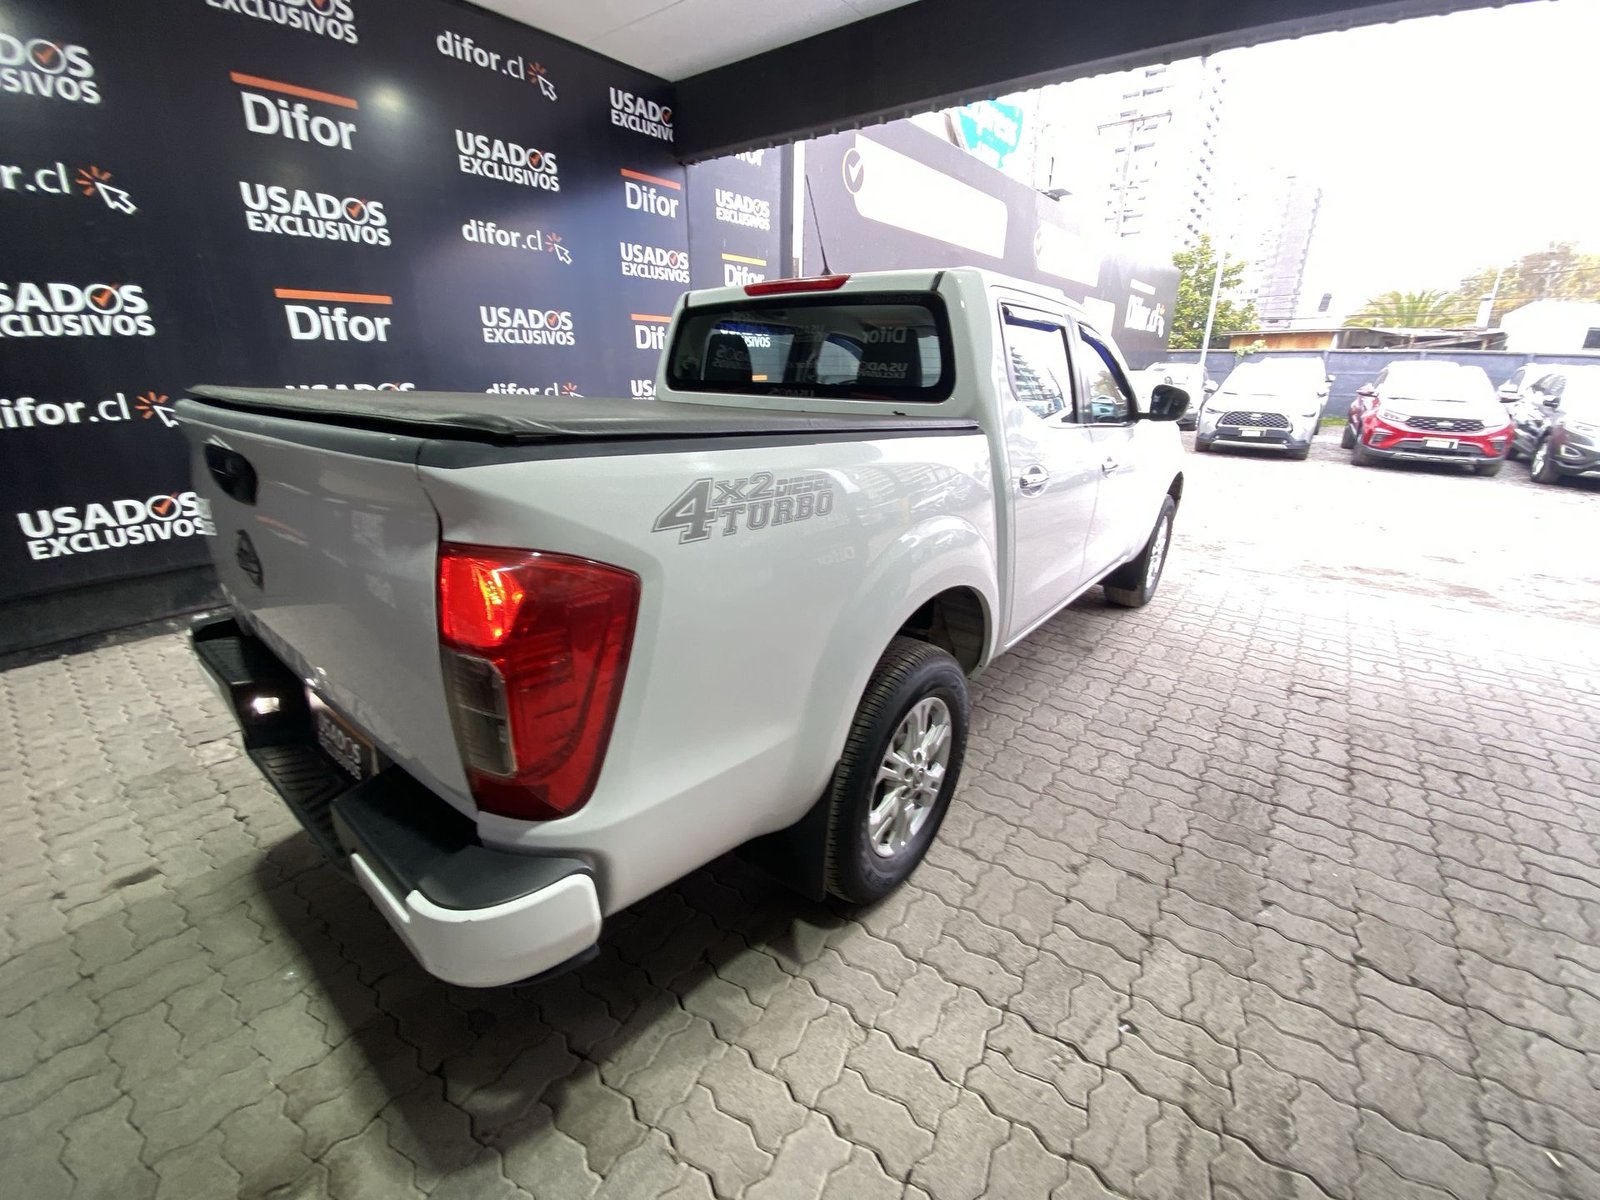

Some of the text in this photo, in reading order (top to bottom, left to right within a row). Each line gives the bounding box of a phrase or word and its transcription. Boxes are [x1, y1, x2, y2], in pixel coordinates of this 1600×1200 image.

[437, 30, 525, 80] difor.cl
[240, 91, 357, 150] Difor
[455, 130, 557, 175] USADOS
[459, 154, 560, 192] EXCLUSIVOS
[239, 181, 388, 227] USADOS
[625, 182, 679, 218] Difor
[715, 189, 770, 218] USADOS
[245, 210, 391, 247] EXCLUSIVOS
[462, 219, 543, 251] difor.cl
[620, 242, 689, 269] USADOS
[622, 262, 690, 284] EXCLUSIVOS
[285, 305, 391, 342] Difor
[480, 306, 572, 331] USADOS
[483, 328, 575, 346] EXCLUSIVOS
[17, 492, 199, 538] USADOS
[719, 490, 835, 536] TURBO
